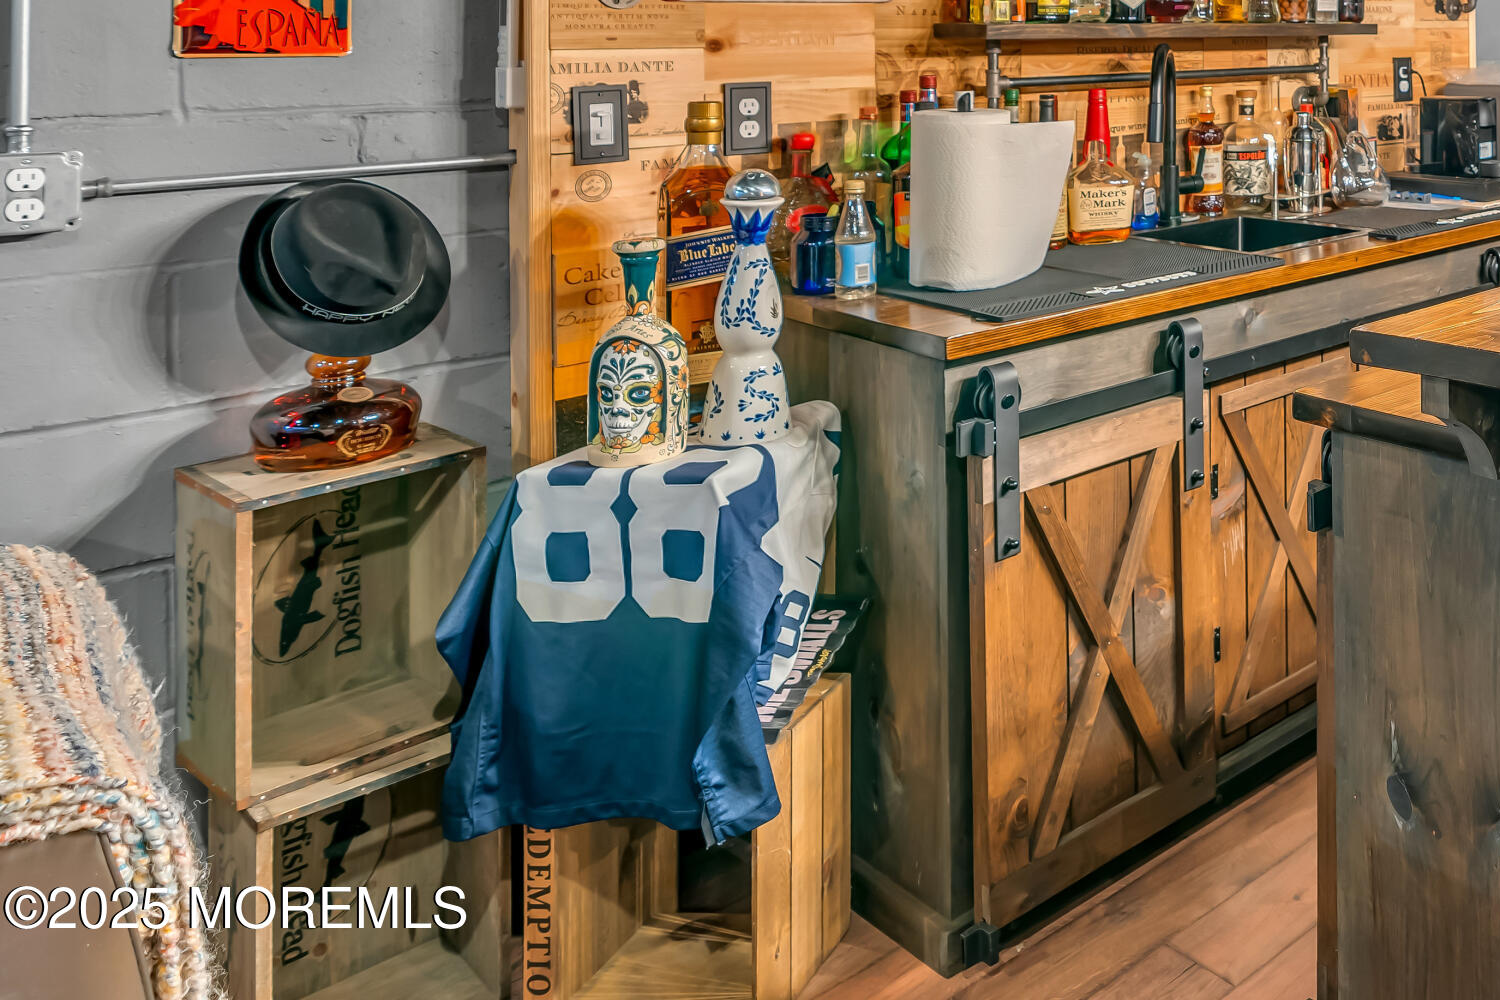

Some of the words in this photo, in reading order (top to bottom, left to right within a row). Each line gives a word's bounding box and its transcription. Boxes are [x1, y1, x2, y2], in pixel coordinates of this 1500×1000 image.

[238, 8, 340, 47] ESPAÑA
[617, 60, 675, 73] DANTE
[1079, 189, 1127, 199] Maker's
[1093, 199, 1126, 208] Mark
[678, 247, 708, 264] Blue
[331, 554, 362, 659] Dogfish
